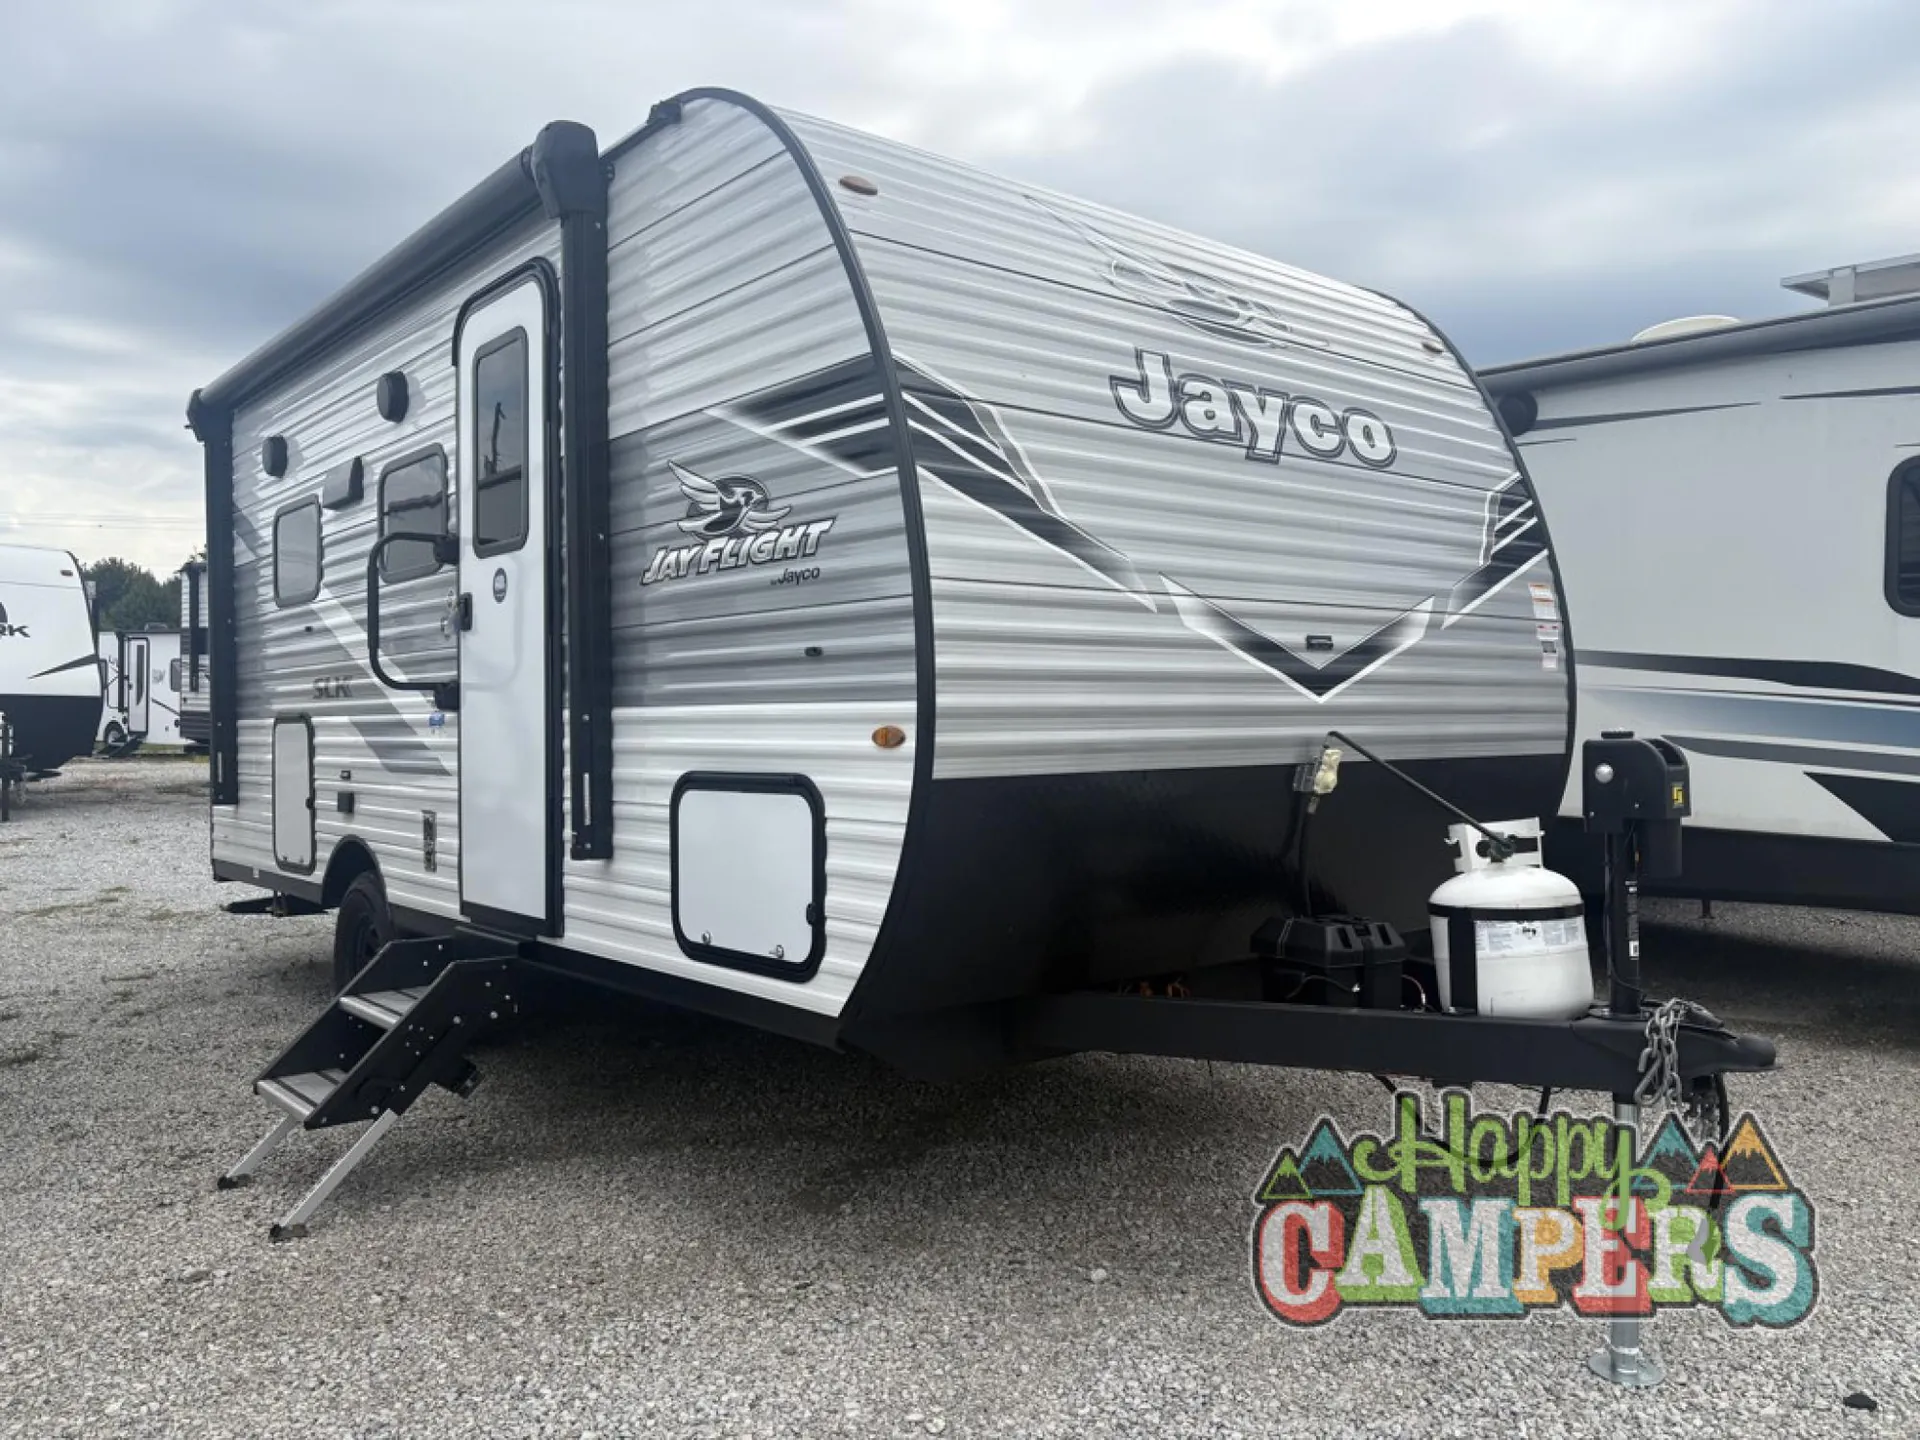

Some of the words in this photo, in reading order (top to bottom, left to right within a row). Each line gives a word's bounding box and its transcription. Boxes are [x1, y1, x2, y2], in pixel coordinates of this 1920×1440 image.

[1109, 348, 1397, 467] Jayco
[641, 545, 700, 585] JAY
[697, 517, 836, 574] FLIGHT
[777, 567, 820, 586] Jayco
[312, 674, 353, 699] SLK
